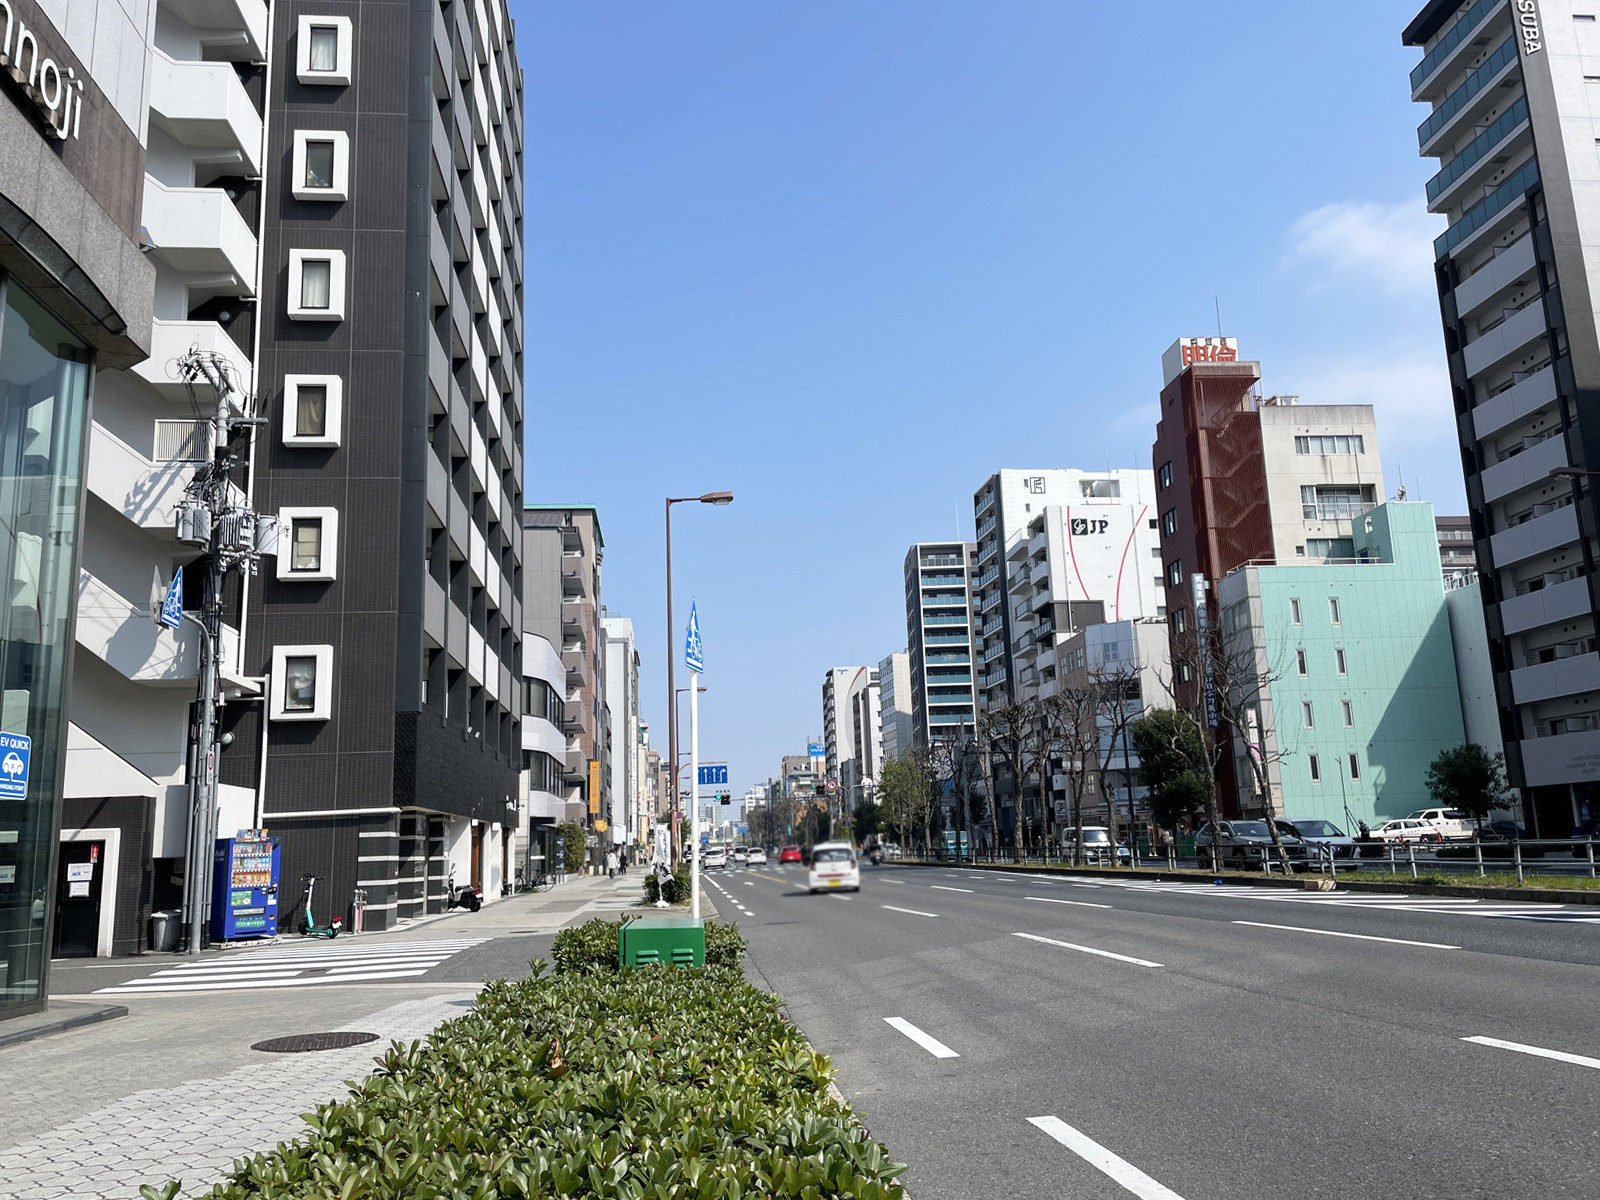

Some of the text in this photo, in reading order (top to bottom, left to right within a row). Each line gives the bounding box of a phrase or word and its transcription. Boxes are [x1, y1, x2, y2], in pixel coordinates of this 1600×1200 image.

[1090, 520, 1108, 534] JP
[0, 737, 29, 750] EV QUICK
